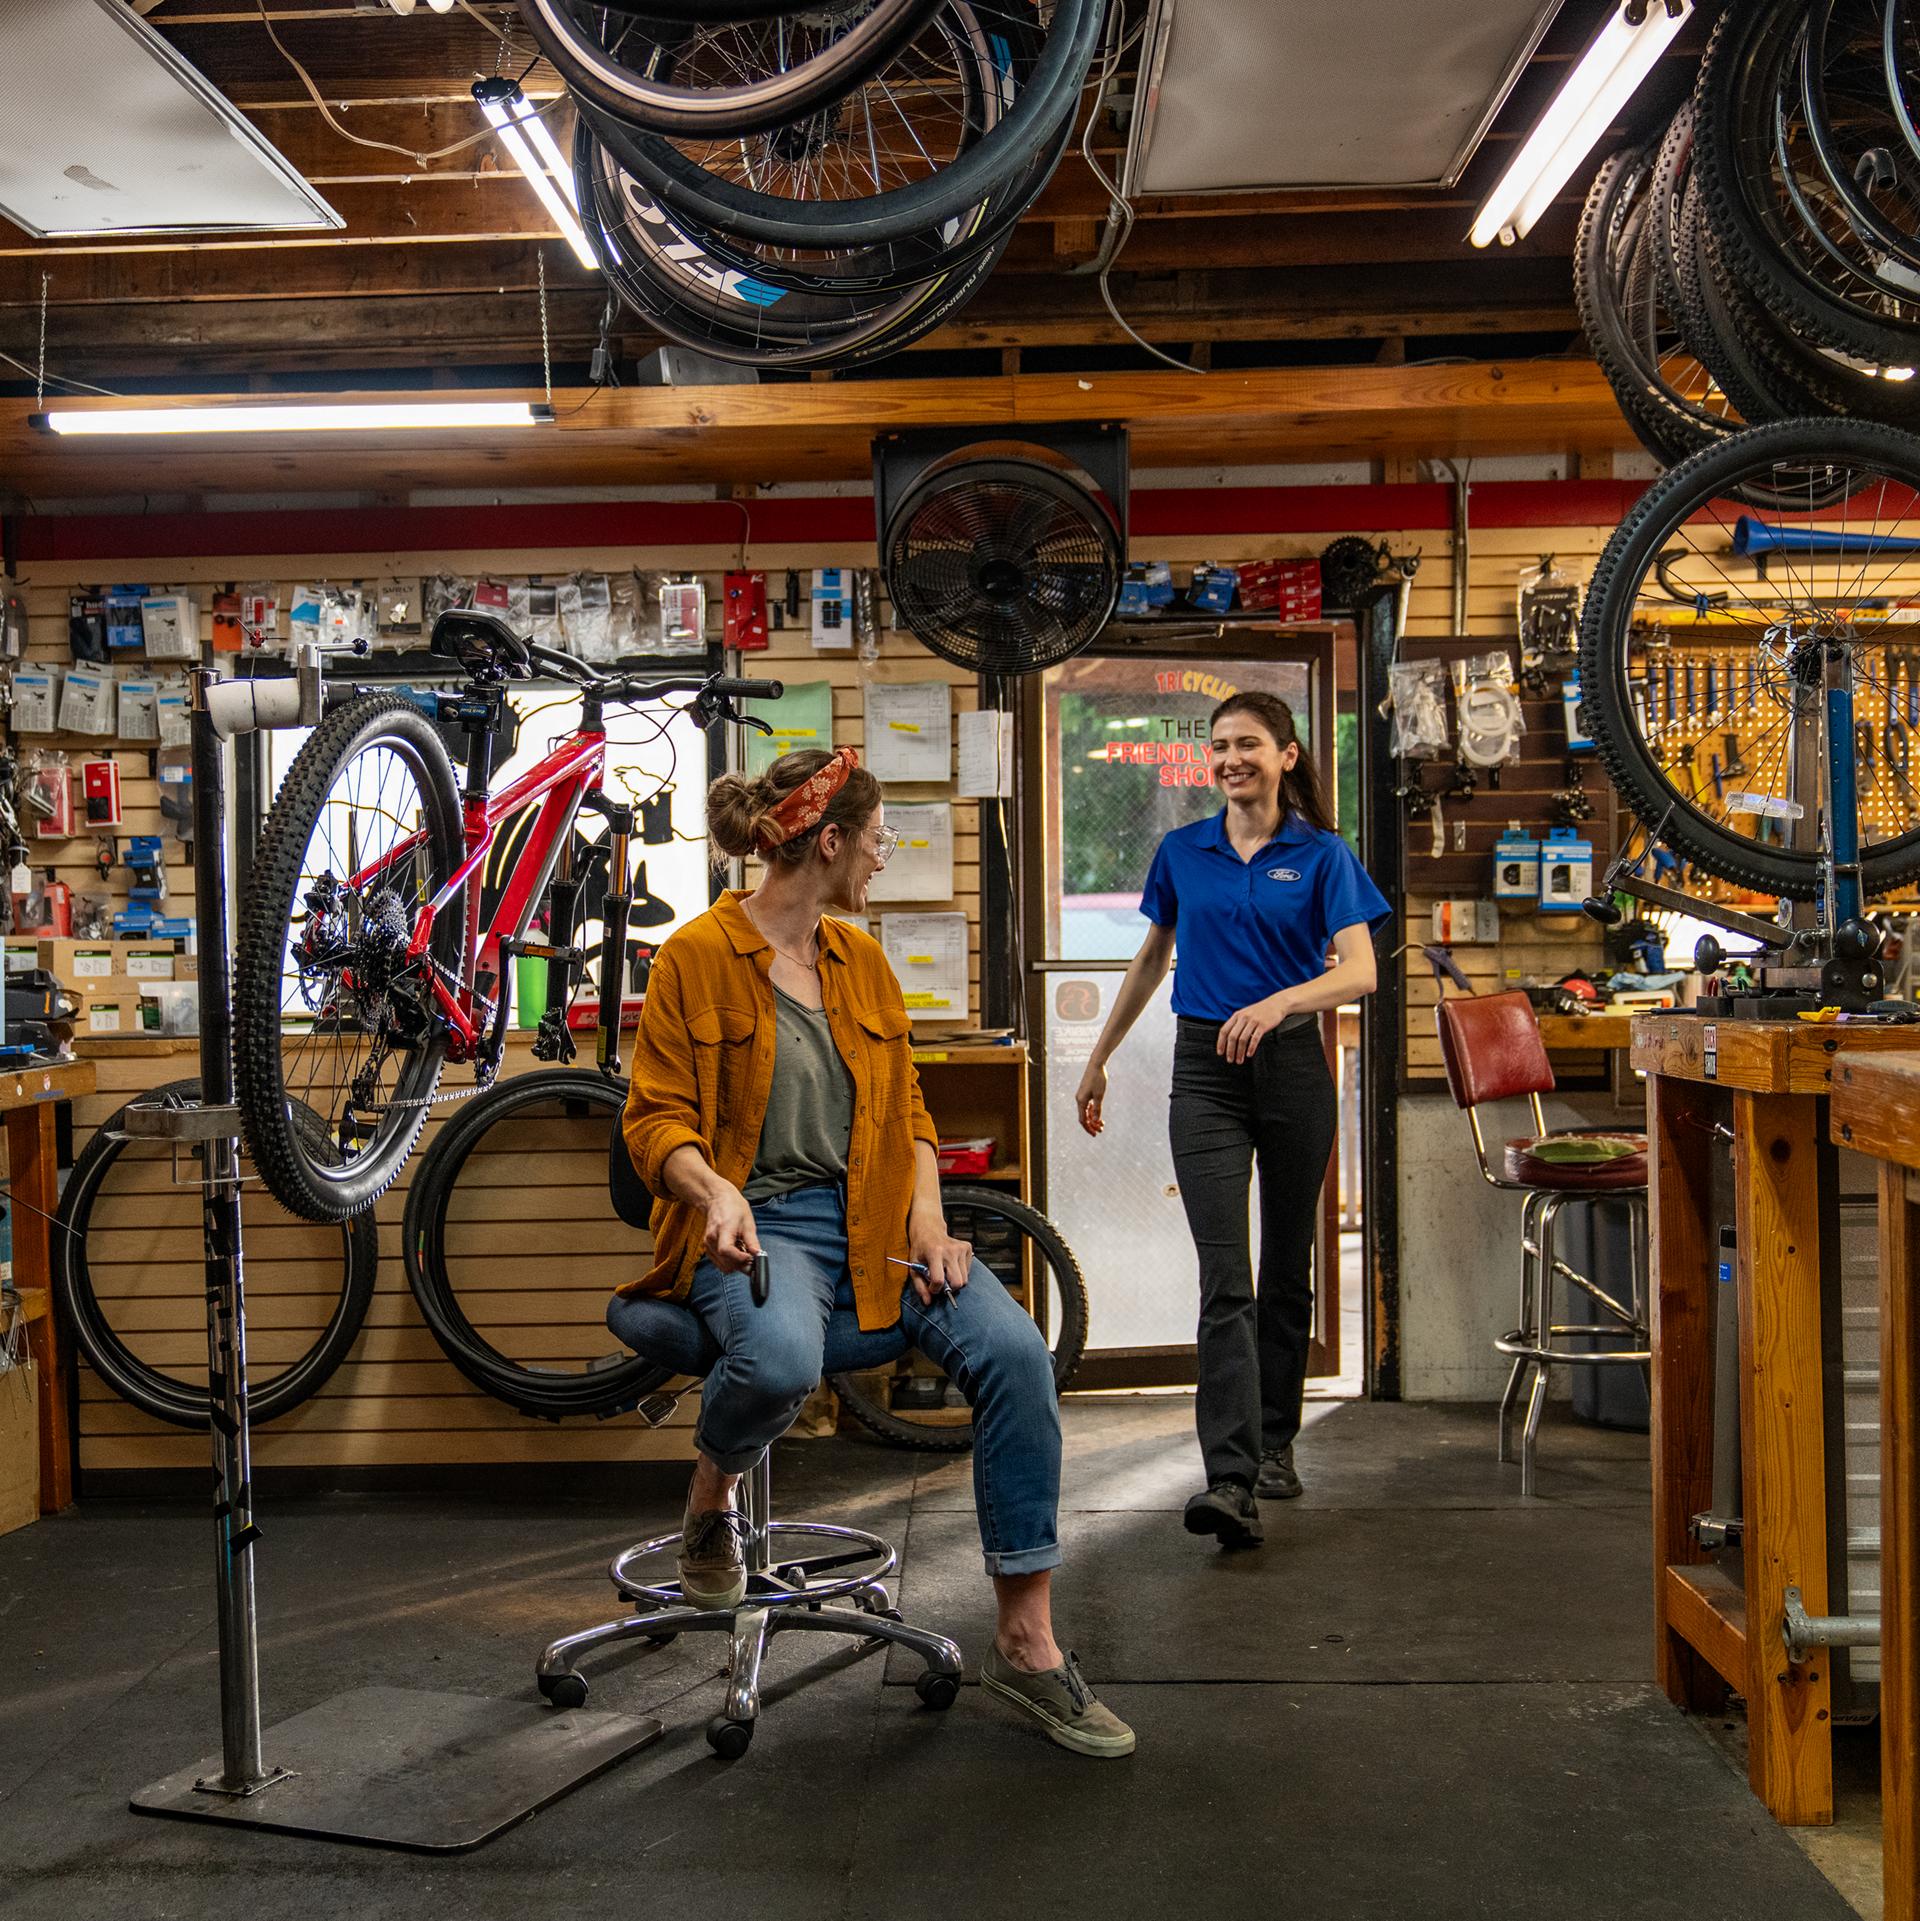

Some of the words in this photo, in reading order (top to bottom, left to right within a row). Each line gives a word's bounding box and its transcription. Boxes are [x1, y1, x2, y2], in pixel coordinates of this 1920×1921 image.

[937, 274, 977, 317] RUBINO
[910, 315, 936, 335] PRO
[1155, 670, 1238, 702] TRICYCLIS
[1160, 719, 1206, 738] THE
[1106, 742, 1213, 764] FRIENDLY
